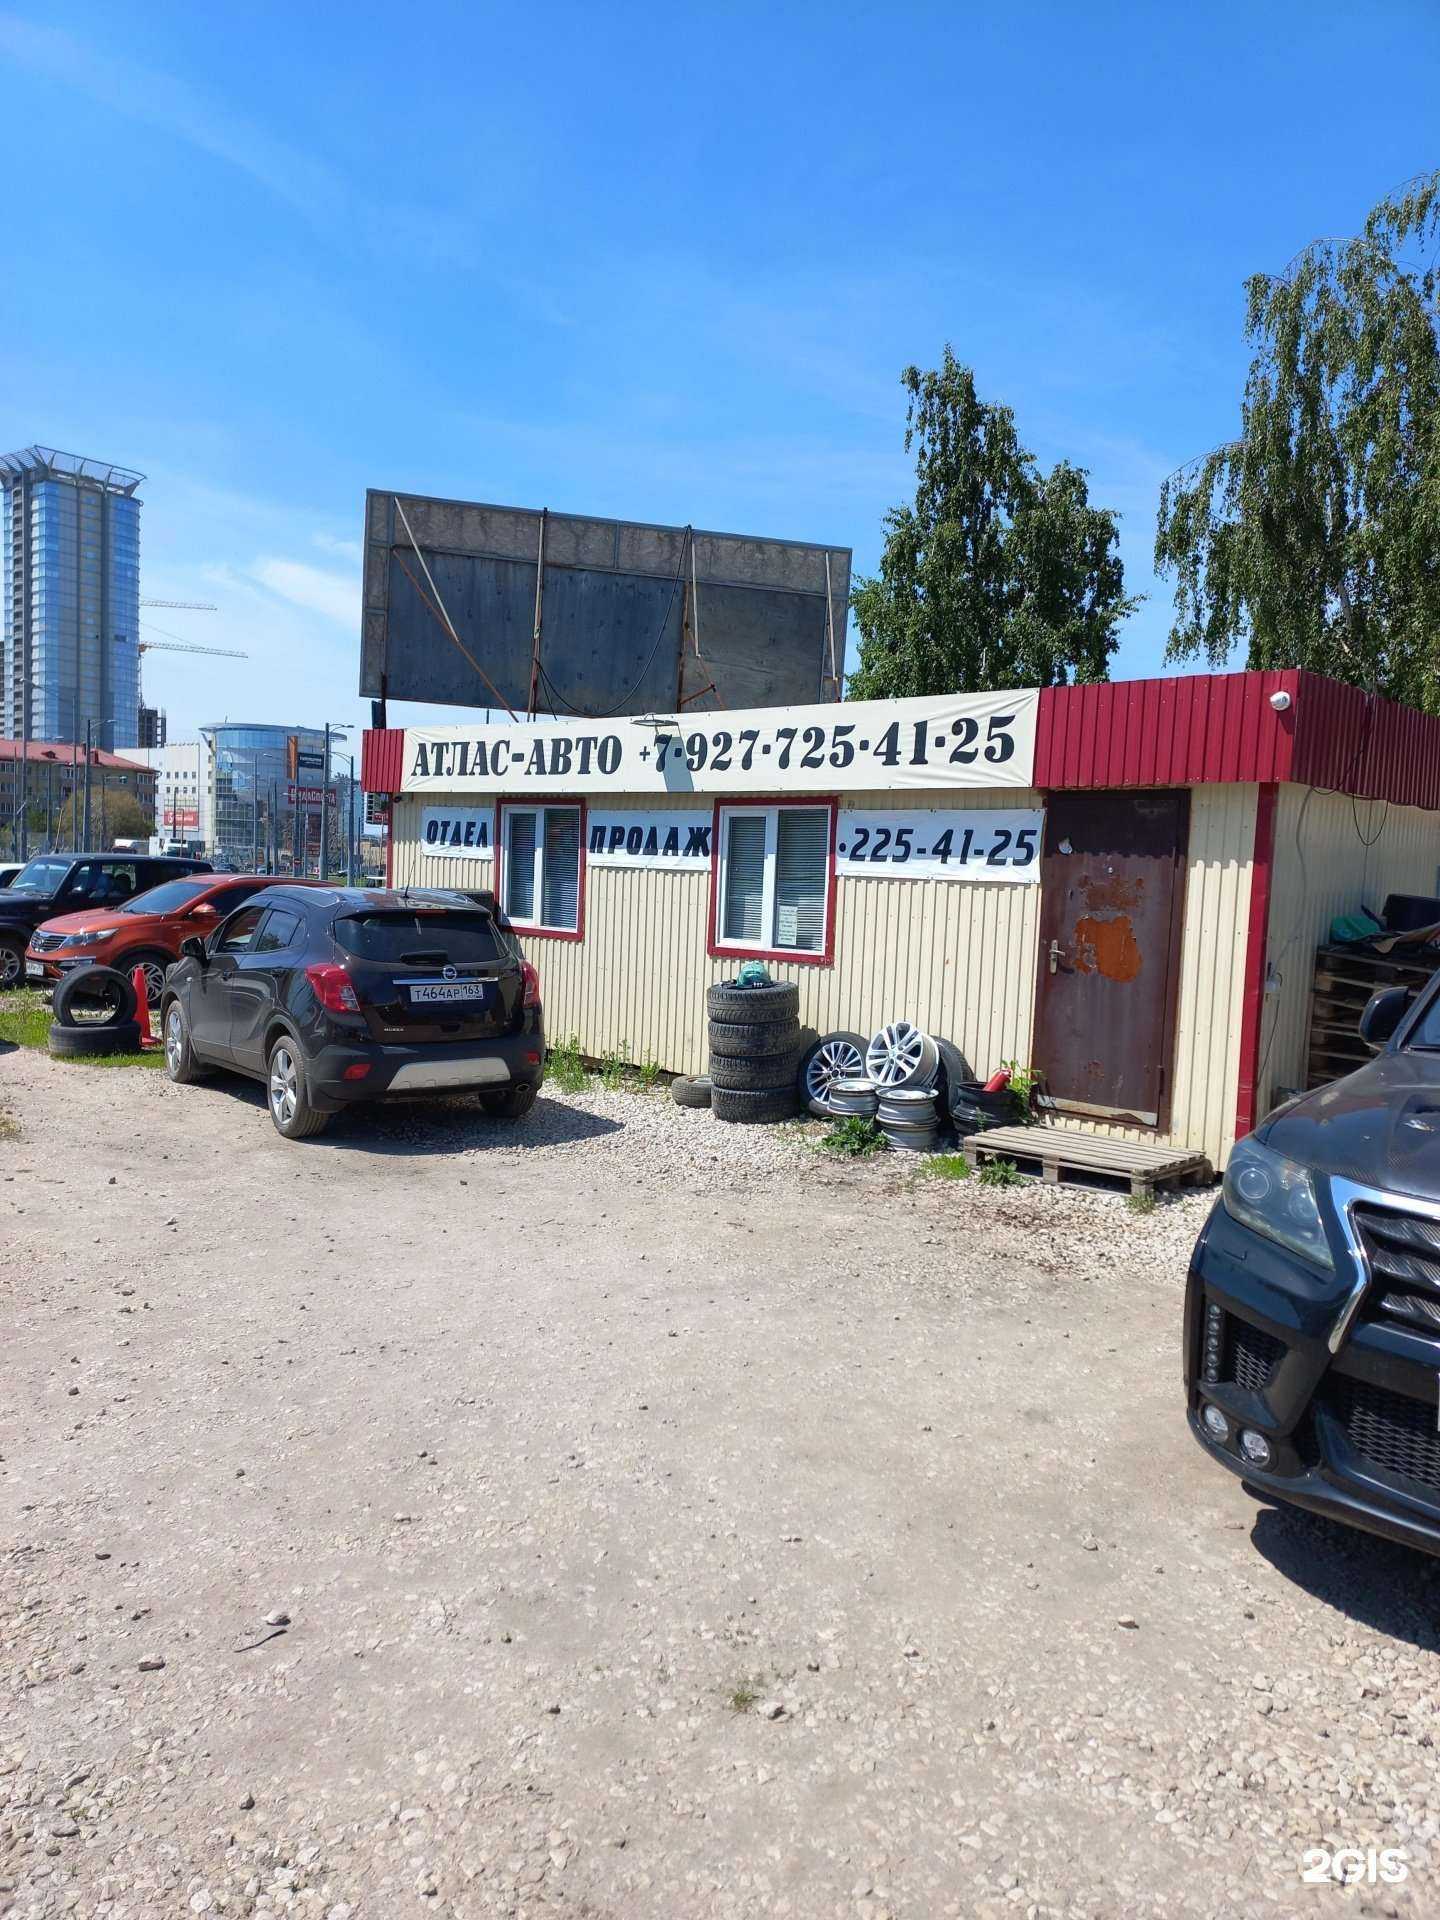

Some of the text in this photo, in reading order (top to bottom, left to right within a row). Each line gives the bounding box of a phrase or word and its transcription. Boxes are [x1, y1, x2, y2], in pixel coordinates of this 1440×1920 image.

[410, 735, 622, 777] АТЛАС-АВТО
[426, 819, 488, 848] ОТДЕЛ
[589, 825, 712, 857] ПРОДАЖ
